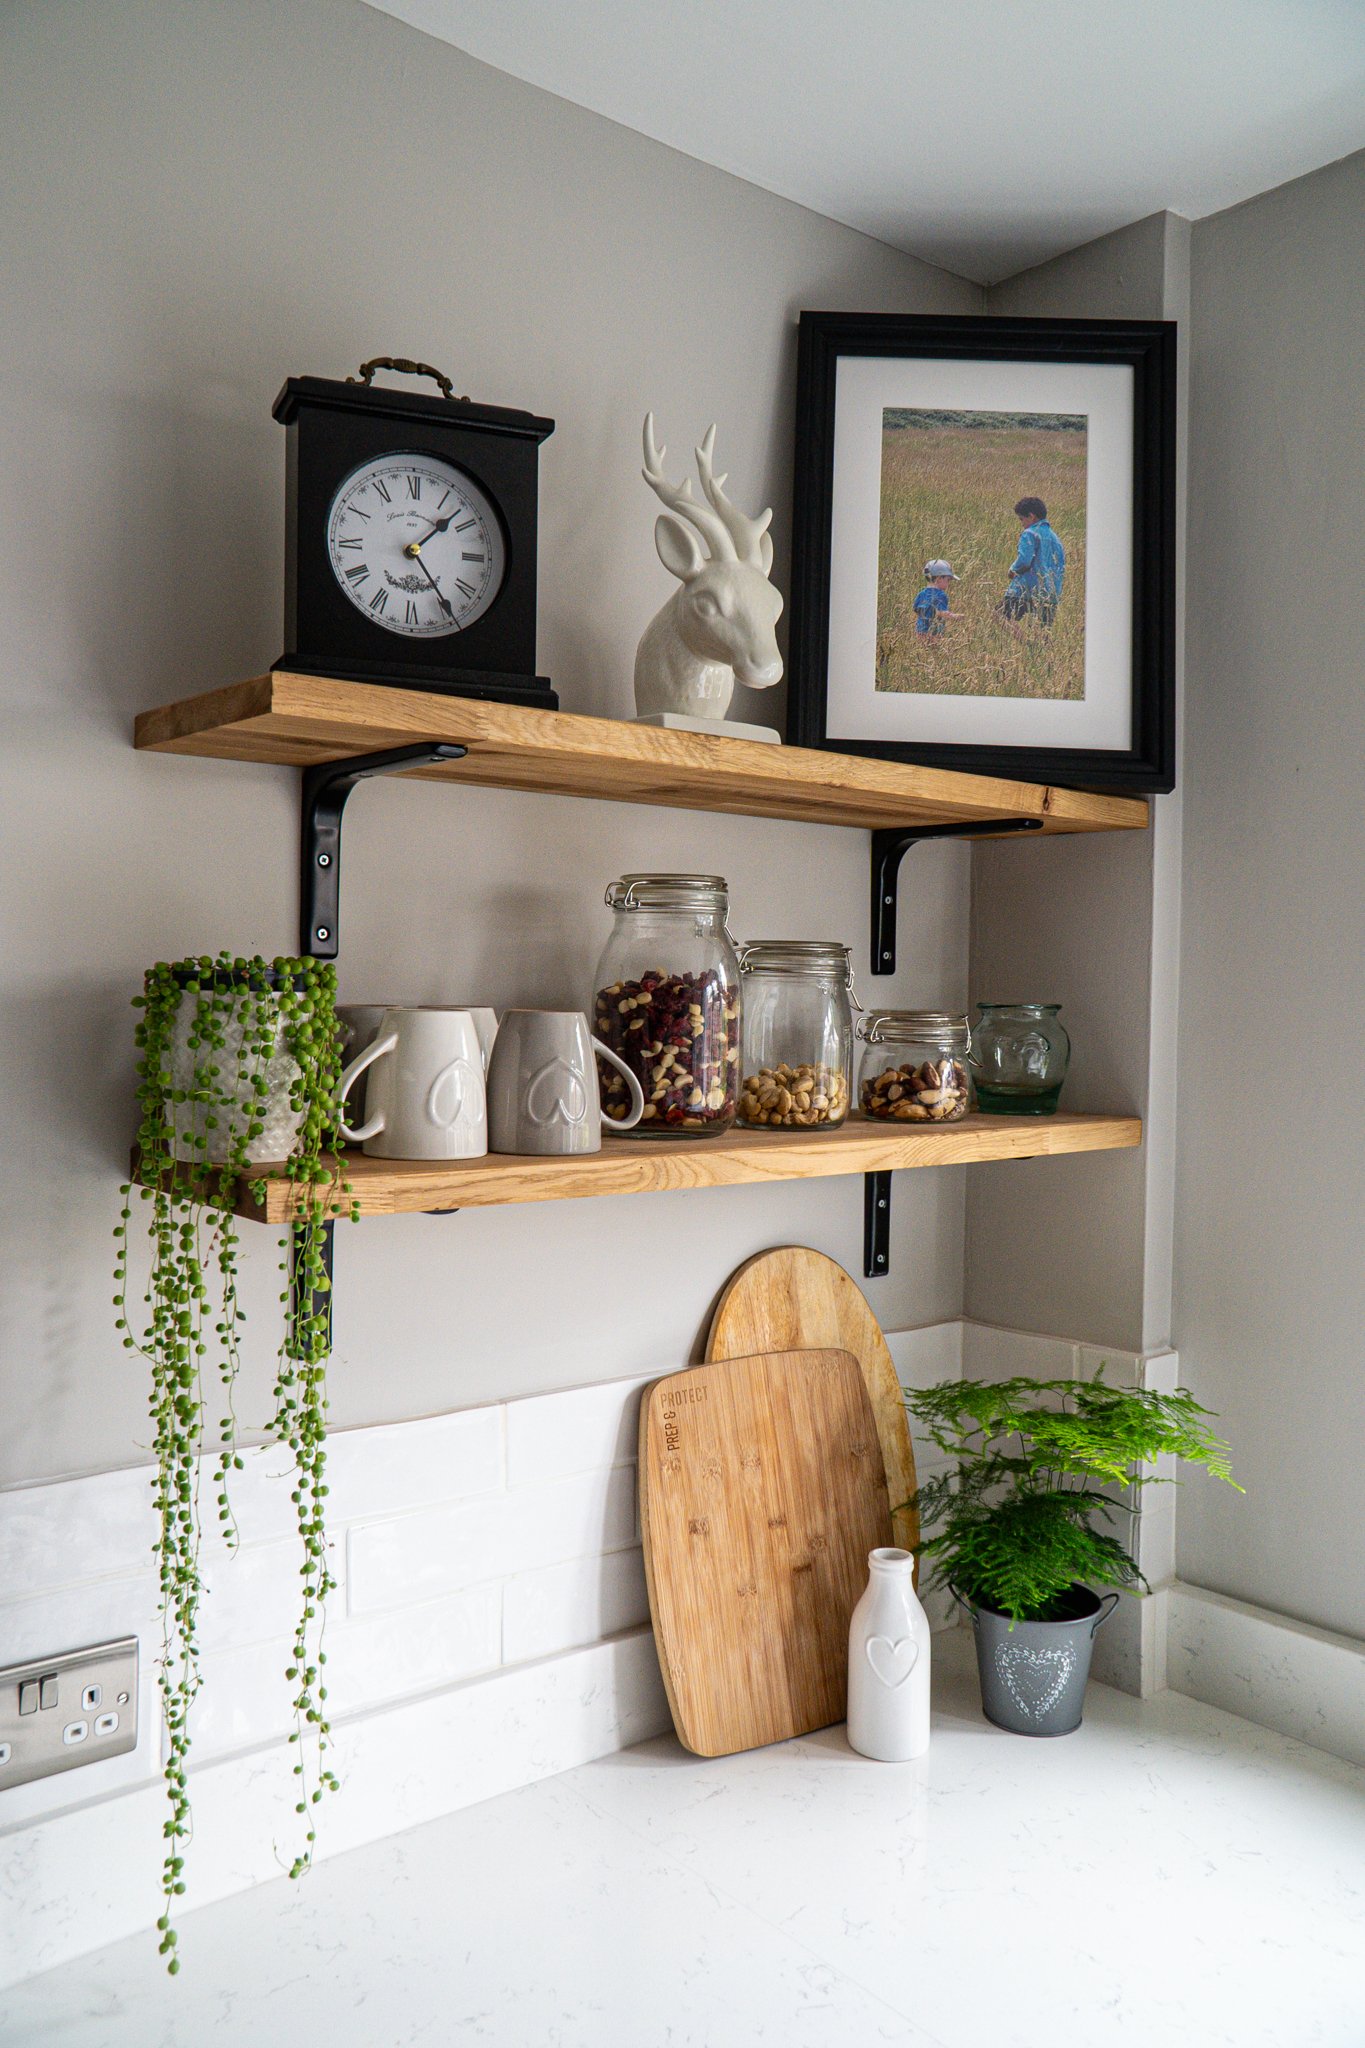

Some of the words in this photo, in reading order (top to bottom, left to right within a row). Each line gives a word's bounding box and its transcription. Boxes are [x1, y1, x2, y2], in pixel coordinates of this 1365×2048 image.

[405, 475, 421, 500] XII
[347, 501, 371, 525] X
[461, 552, 485, 563] III
[661, 1386, 708, 1408] PROTECT
[664, 1411, 676, 1419] &
[665, 1423, 680, 1451] PREP
